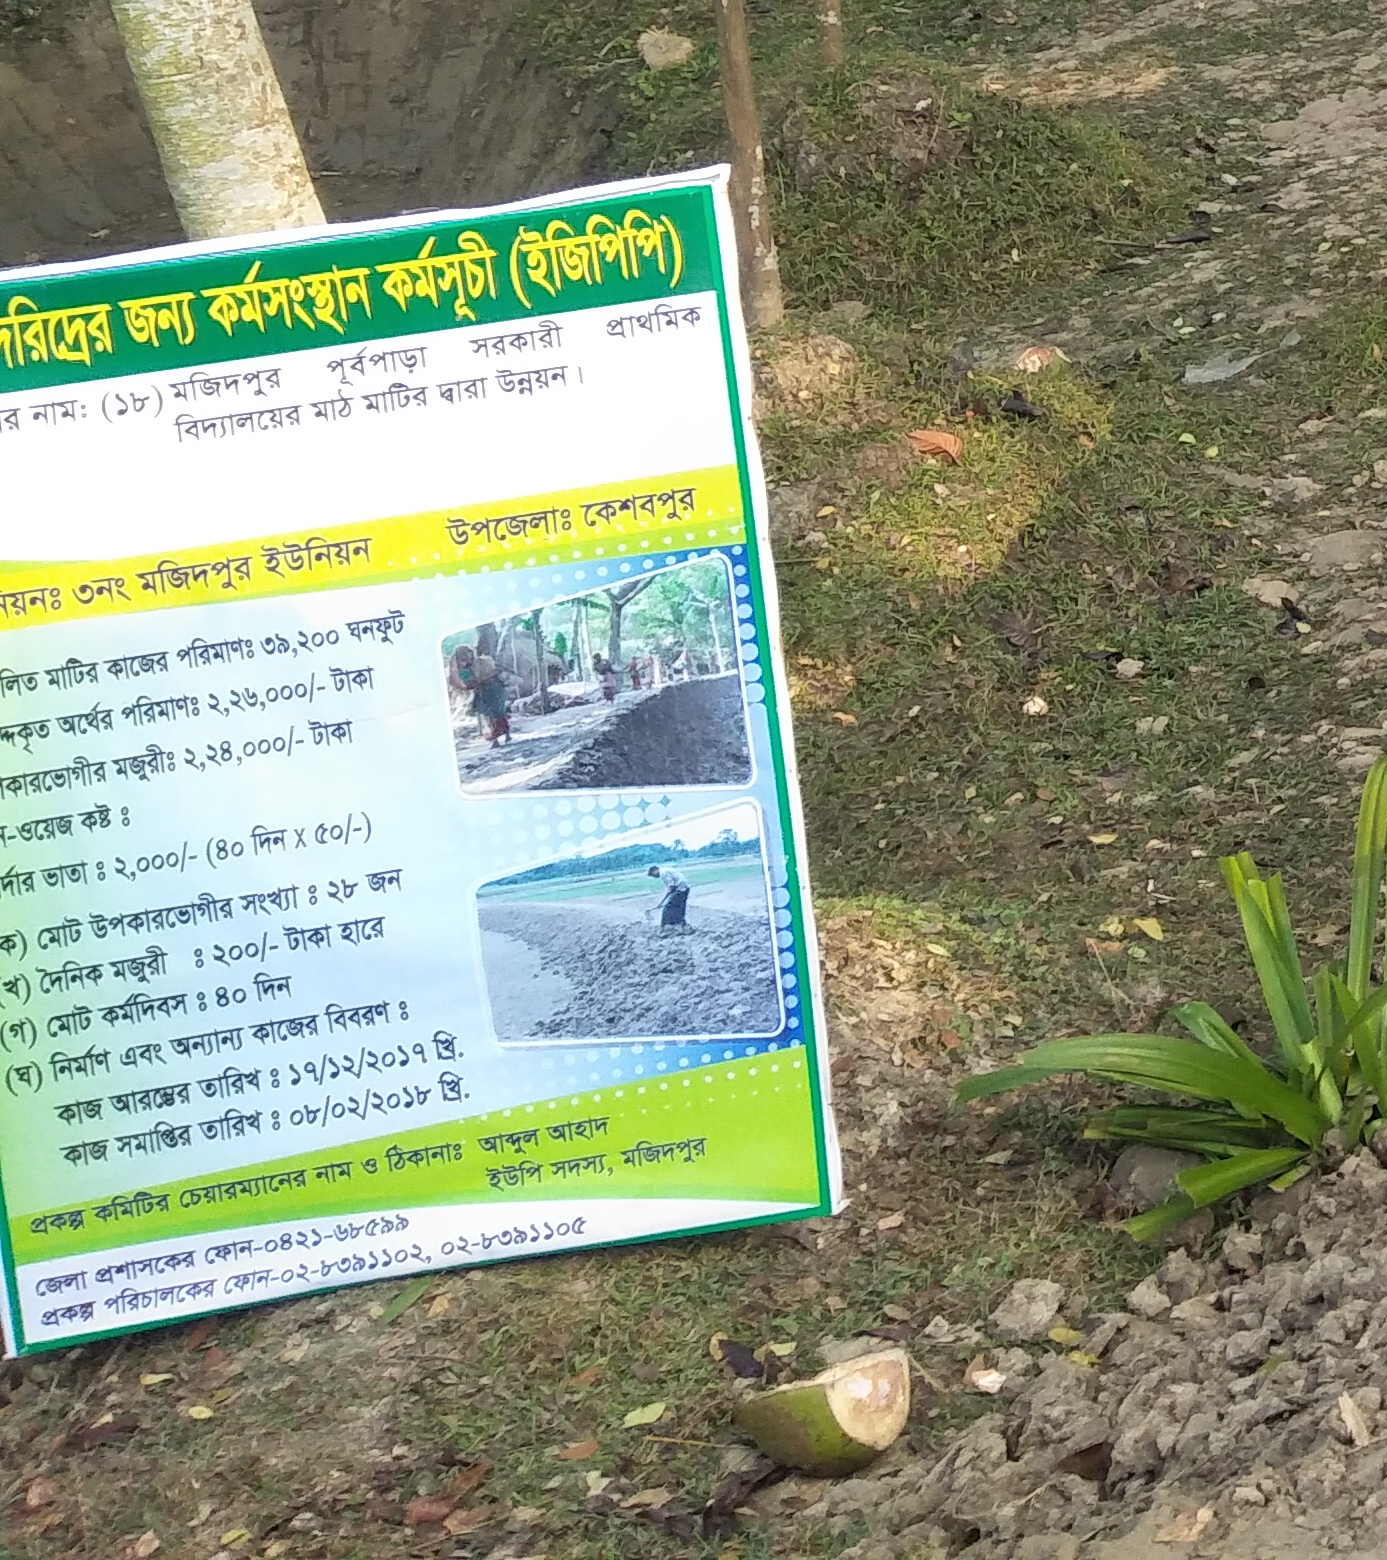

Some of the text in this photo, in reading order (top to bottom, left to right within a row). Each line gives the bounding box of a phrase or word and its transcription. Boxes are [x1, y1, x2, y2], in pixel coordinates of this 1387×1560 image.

[117, 292, 197, 347] জন্য
[201, 261, 373, 336] কর্মসংস্থান
[376, 230, 497, 322] কর্মসূচী
[510, 209, 683, 309] (ইজিপিপি)
[102, 385, 163, 424] (১৮)
[169, 368, 282, 402] মজিদপুর
[327, 346, 427, 385] পূর্বপাড়া
[469, 320, 564, 357] সরকারী
[606, 304, 702, 339] প্রাথমিক
[174, 406, 300, 442] বিদ্যালয়ের
[309, 396, 354, 422] মাঠ
[361, 383, 428, 414] মাটির
[436, 377, 488, 405] দ্বারা
[579, 488, 697, 528] কেশবপুর
[72, 578, 132, 606] ৩নং
[135, 556, 253, 594] মজিদপুর
[261, 537, 373, 577] ইউনিয়ন
[43, 657, 99, 690] মাটির
[103, 652, 169, 681] কাজের
[261, 630, 339, 658] ৩৯,২০০
[346, 610, 405, 644] ঘনফুট
[54, 701, 114, 737] অর্থের
[207, 673, 326, 717] ২,২৬,০০০/-
[330, 667, 375, 694] টাকা
[0, 756, 106, 799] কারভোগীর
[184, 726, 304, 772] ২,২৪,০০০/-
[308, 719, 354, 746] টাকা
[40, 860, 88, 888] ভাতা
[114, 841, 198, 882] ২,০০০/-
[206, 838, 245, 869] (৪০
[250, 825, 287, 857] দিন
[314, 811, 373, 846] ৫০/-)
[37, 916, 84, 950] মোট
[87, 893, 234, 939] উপকারভোগীর
[240, 883, 298, 916] সংখ্যা
[326, 879, 358, 902] ২৮
[365, 868, 403, 893] জন
[35, 960, 104, 993] দৈনিক
[109, 945, 168, 984] মজুরী
[213, 932, 279, 968] ২০০/-
[283, 924, 332, 954] টাকা
[338, 916, 385, 943] হারে
[0, 1017, 37, 1053] (গ)
[47, 1004, 93, 1038] মোট
[97, 993, 189, 1028] কর্মদিবস
[215, 986, 247, 1008] ৪০
[252, 971, 293, 1002] দিন
[5, 1060, 42, 1096] (ঘ)
[48, 1043, 111, 1082] নির্মাণ
[120, 1043, 163, 1069] এবং
[169, 1026, 243, 1057] অন্যান্য
[251, 1012, 319, 1042] কাজের
[325, 998, 391, 1034] বিবরণ
[53, 1096, 104, 1126] কাজ
[107, 1083, 191, 1117] আরম্ভের
[200, 1066, 260, 1099] তারিখ
[289, 1041, 428, 1085] ১৭/১২/২০১৭
[58, 1141, 109, 1169] কাজ
[115, 1124, 192, 1160] সমাপ্তির
[199, 1110, 261, 1143] তারিখ
[290, 1084, 431, 1128] ০৮/০২/২০১৮
[486, 1161, 543, 1192] ইউপি
[620, 1136, 708, 1169] মজিদপুর
[29, 1209, 86, 1235] প্রকল্প
[90, 1190, 170, 1222] কমিটির
[179, 1168, 307, 1209] চেয়ারম্যানের
[311, 1159, 353, 1184] নাম
[360, 1155, 378, 1175] ও
[545, 1115, 610, 1142] আহাদ
[34, 1270, 88, 1298] জেলা
[95, 1251, 196, 1285] প্রশাসকের
[41, 1300, 95, 1328] প্রকল্প
[103, 1279, 218, 1316] পরিচালকের
